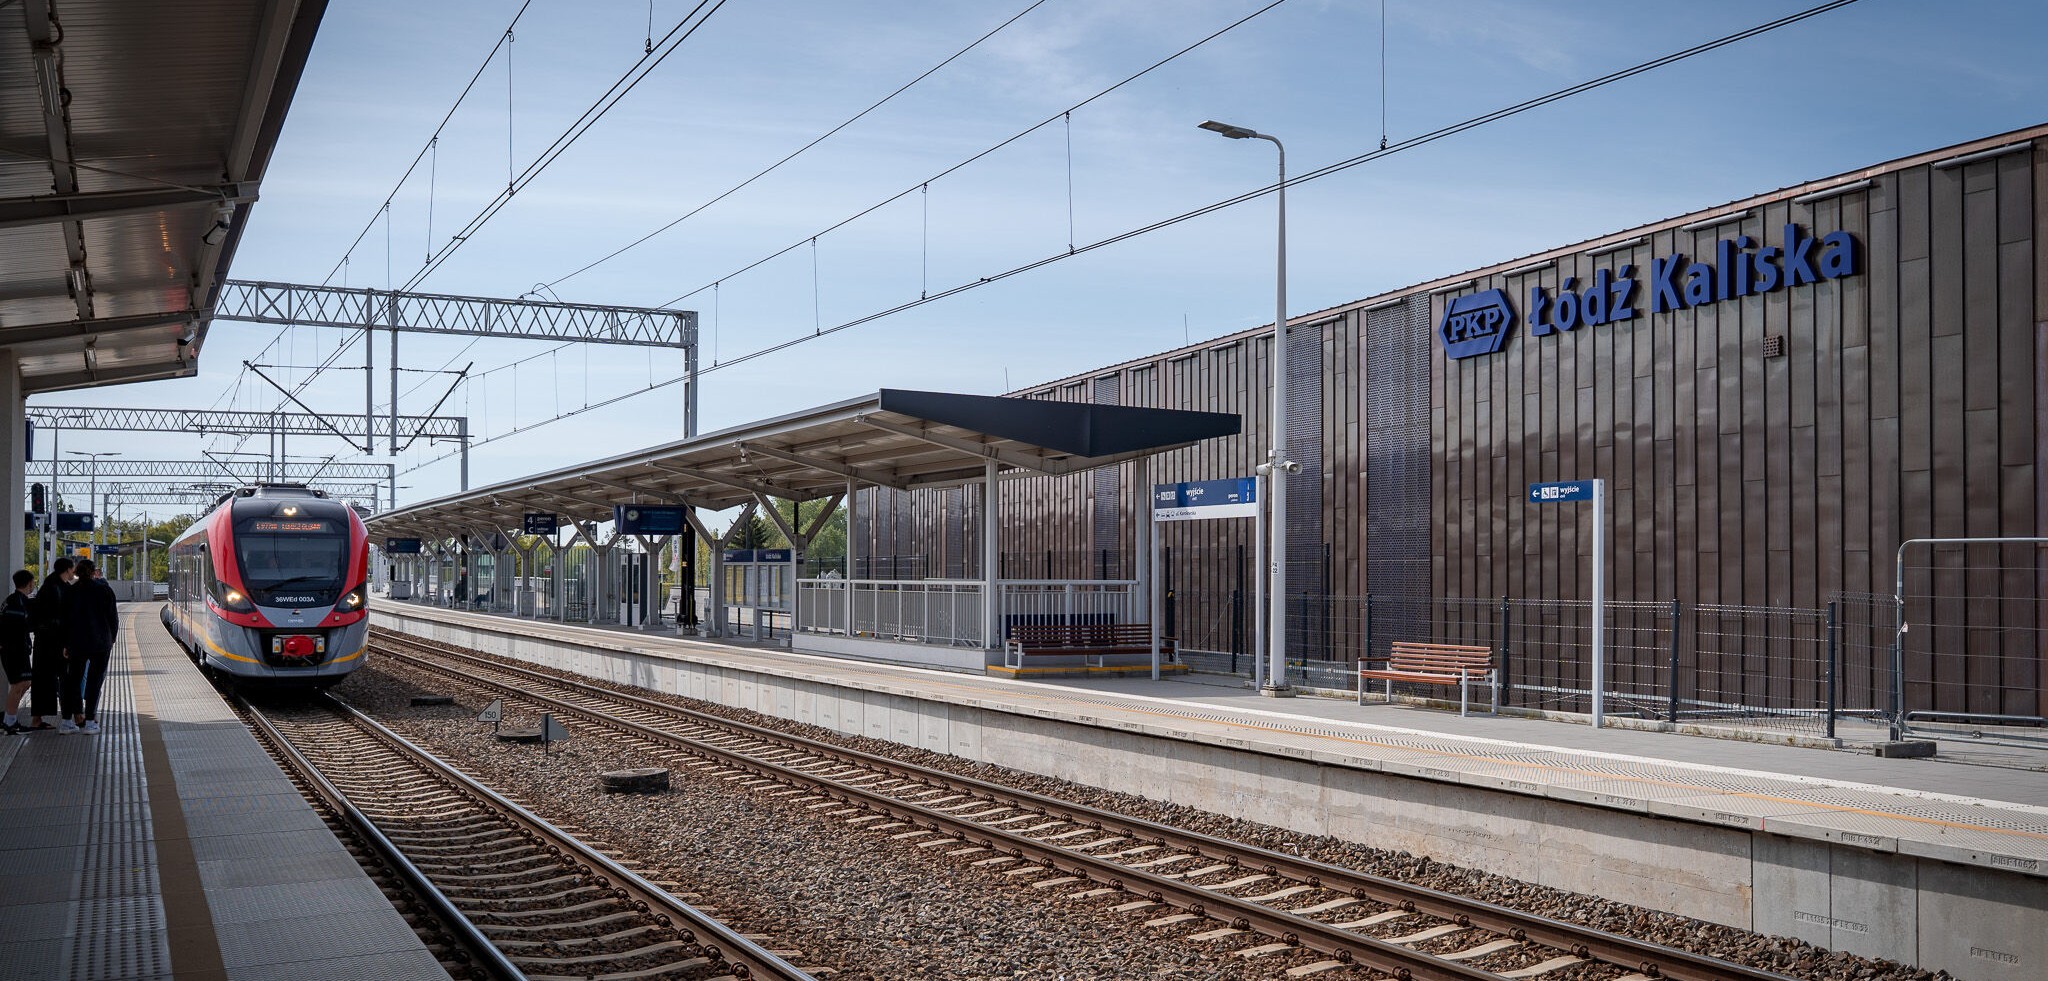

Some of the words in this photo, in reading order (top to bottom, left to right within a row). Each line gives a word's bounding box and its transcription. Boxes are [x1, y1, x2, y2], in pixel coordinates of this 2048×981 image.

[1527, 264, 1638, 337] Łódź
[1651, 223, 1857, 313] Kaliska
[1449, 308, 1500, 341] PKP
[1185, 487, 1204, 497] wyjście
[1559, 485, 1580, 495] wyjście
[527, 516, 534, 524] 4
[484, 710, 497, 719] 150
